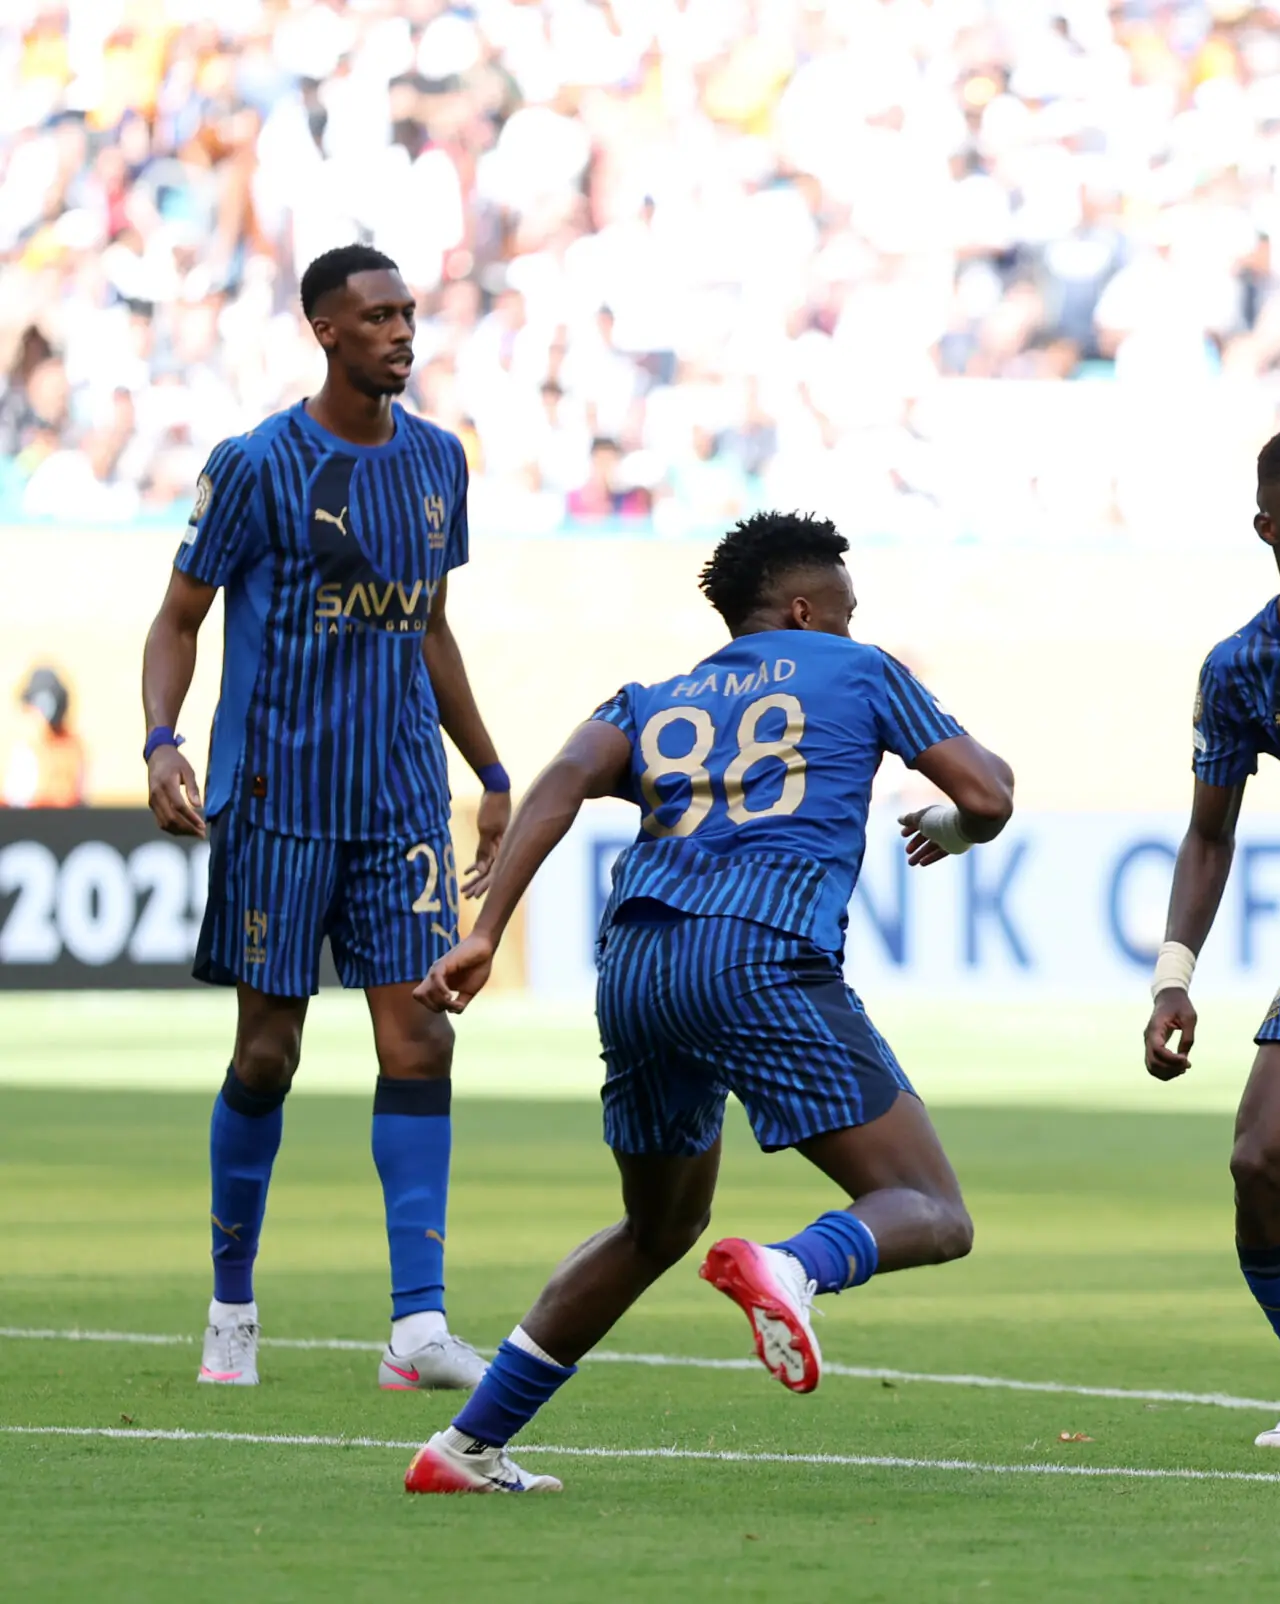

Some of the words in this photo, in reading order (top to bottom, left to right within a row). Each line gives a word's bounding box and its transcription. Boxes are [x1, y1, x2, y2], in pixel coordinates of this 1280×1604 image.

[315, 579, 438, 617] SAVVY
[671, 659, 796, 697] HAMAD
[640, 693, 807, 837] 88
